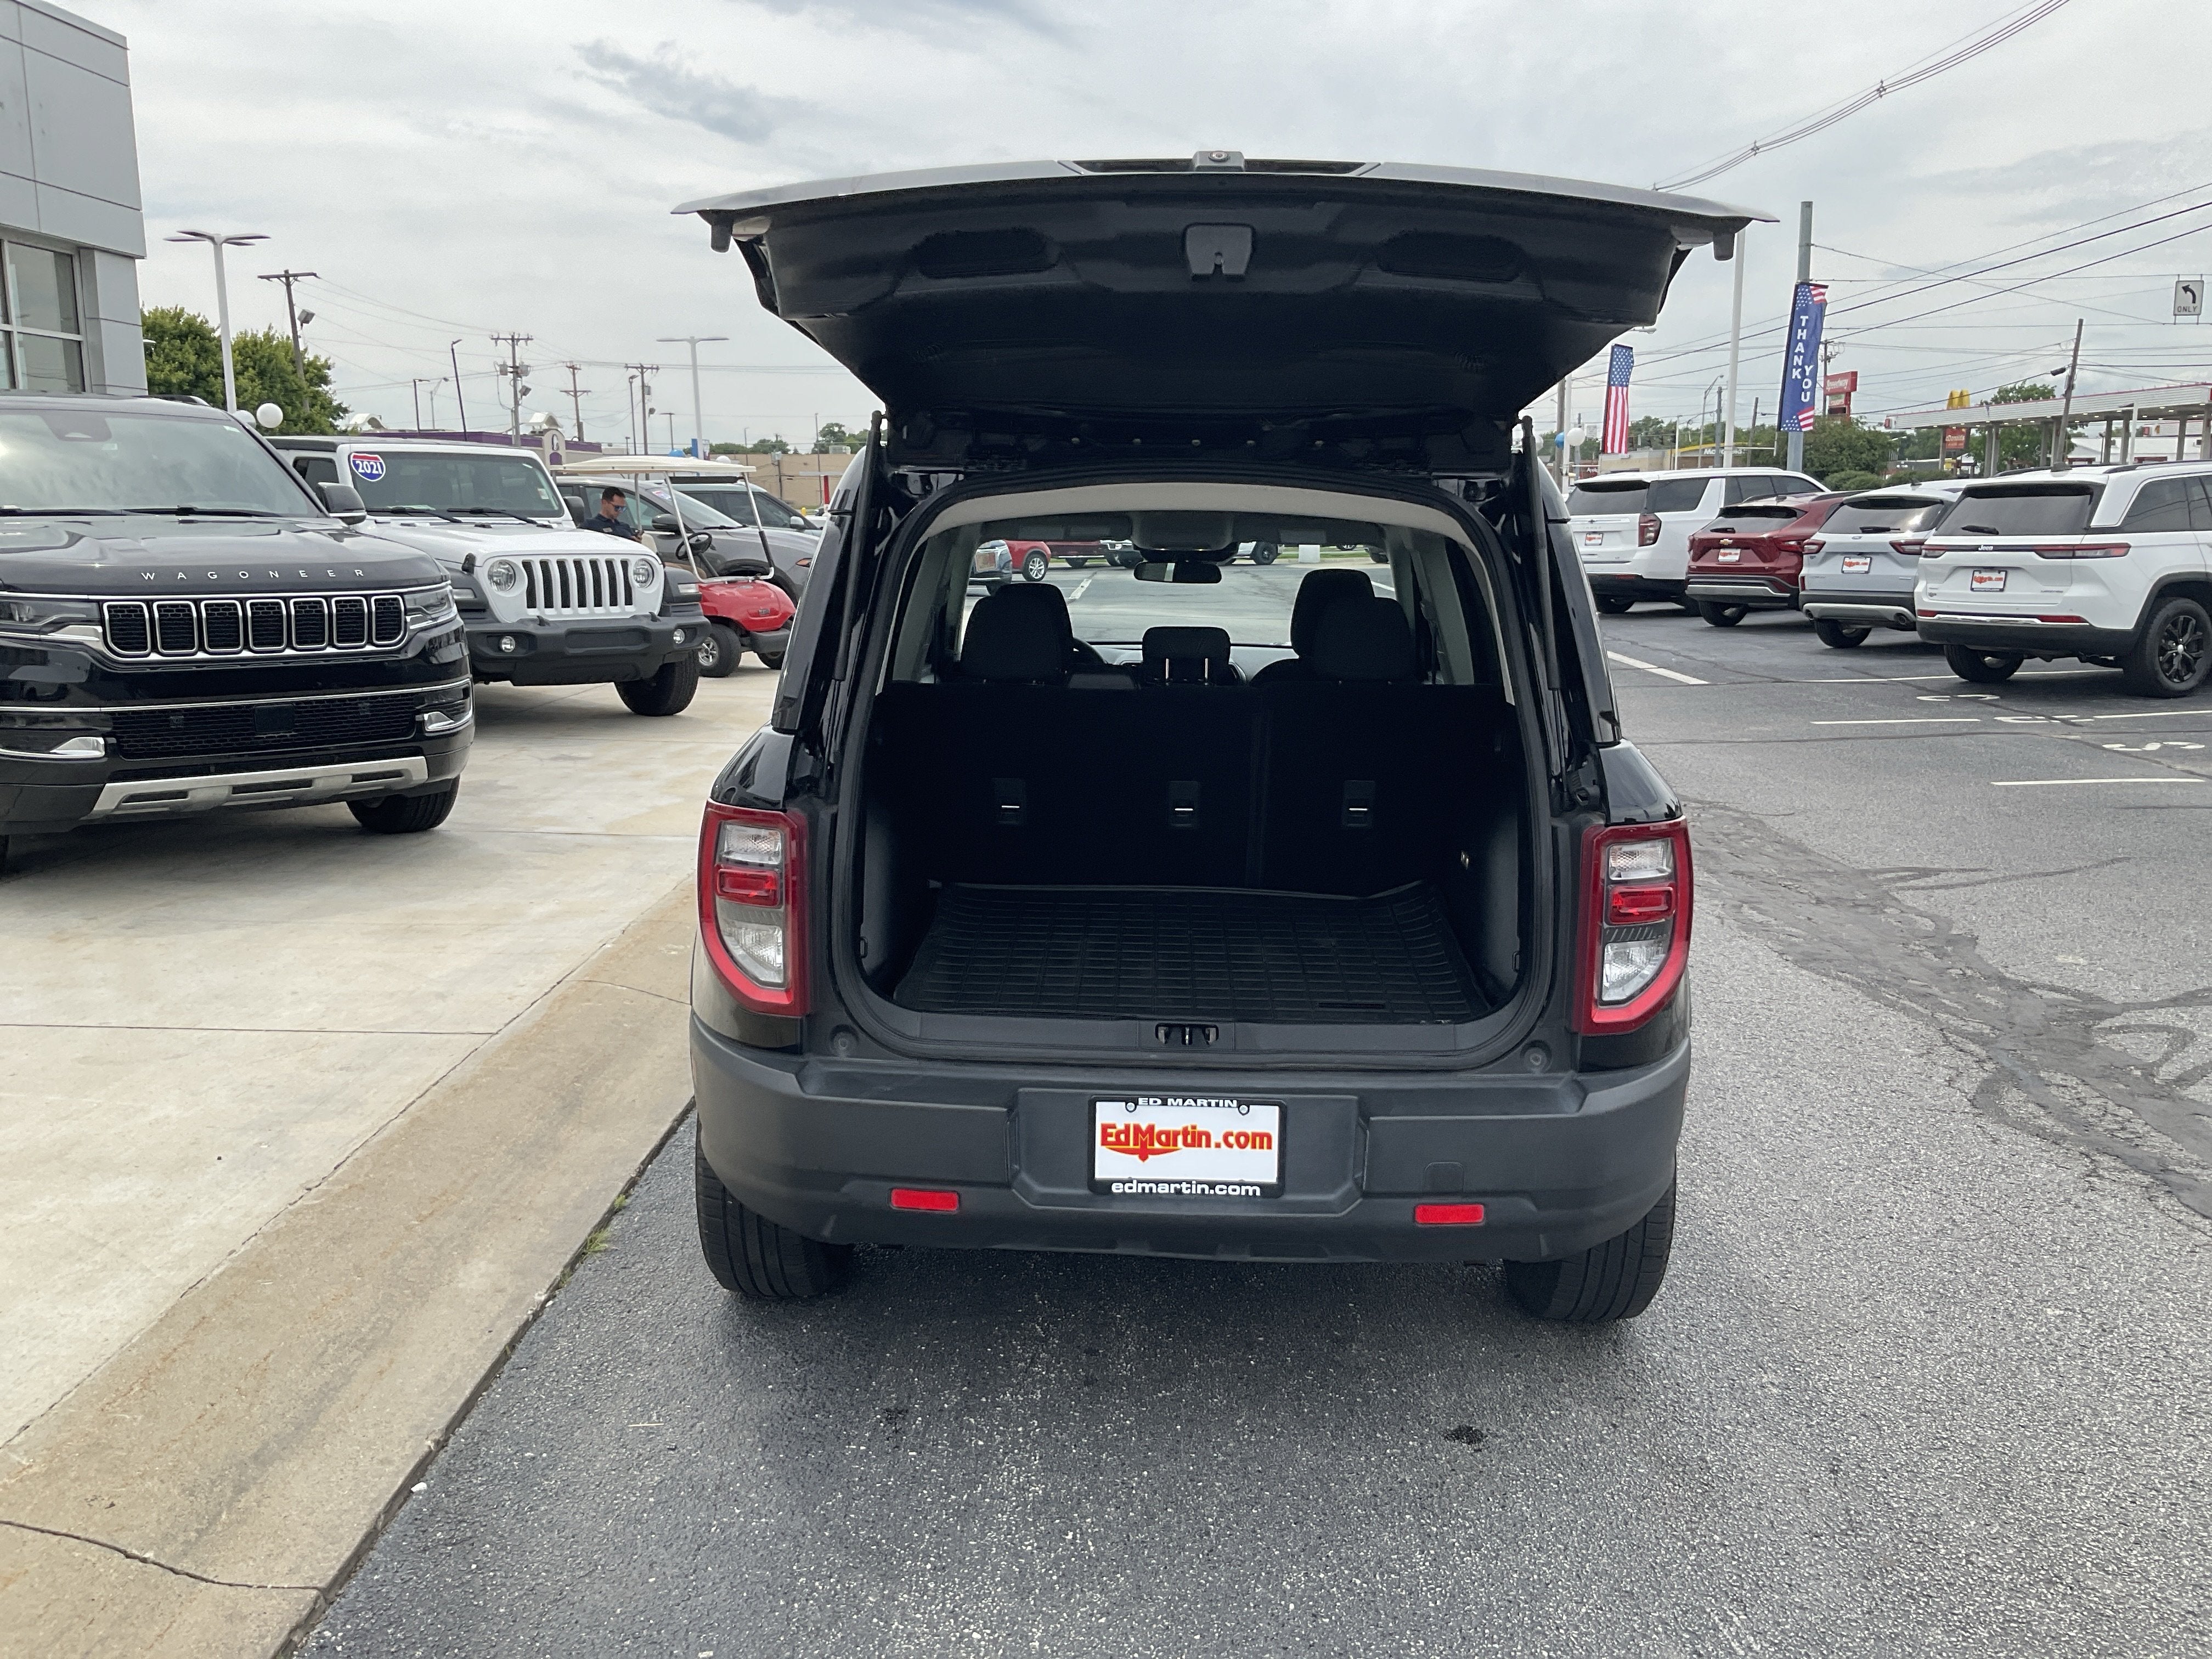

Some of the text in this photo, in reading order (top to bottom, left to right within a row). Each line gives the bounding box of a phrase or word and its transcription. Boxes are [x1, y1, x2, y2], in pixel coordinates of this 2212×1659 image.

[1792, 315, 1814, 402] THANK YOU
[356, 460, 383, 475] 2021
[141, 569, 364, 580] WAGONEER
[1138, 1097, 1238, 1108] ED MARTIN
[1100, 1122, 1273, 1153] EdMartin.com
[1111, 1180, 1261, 1197] edmartin.com
